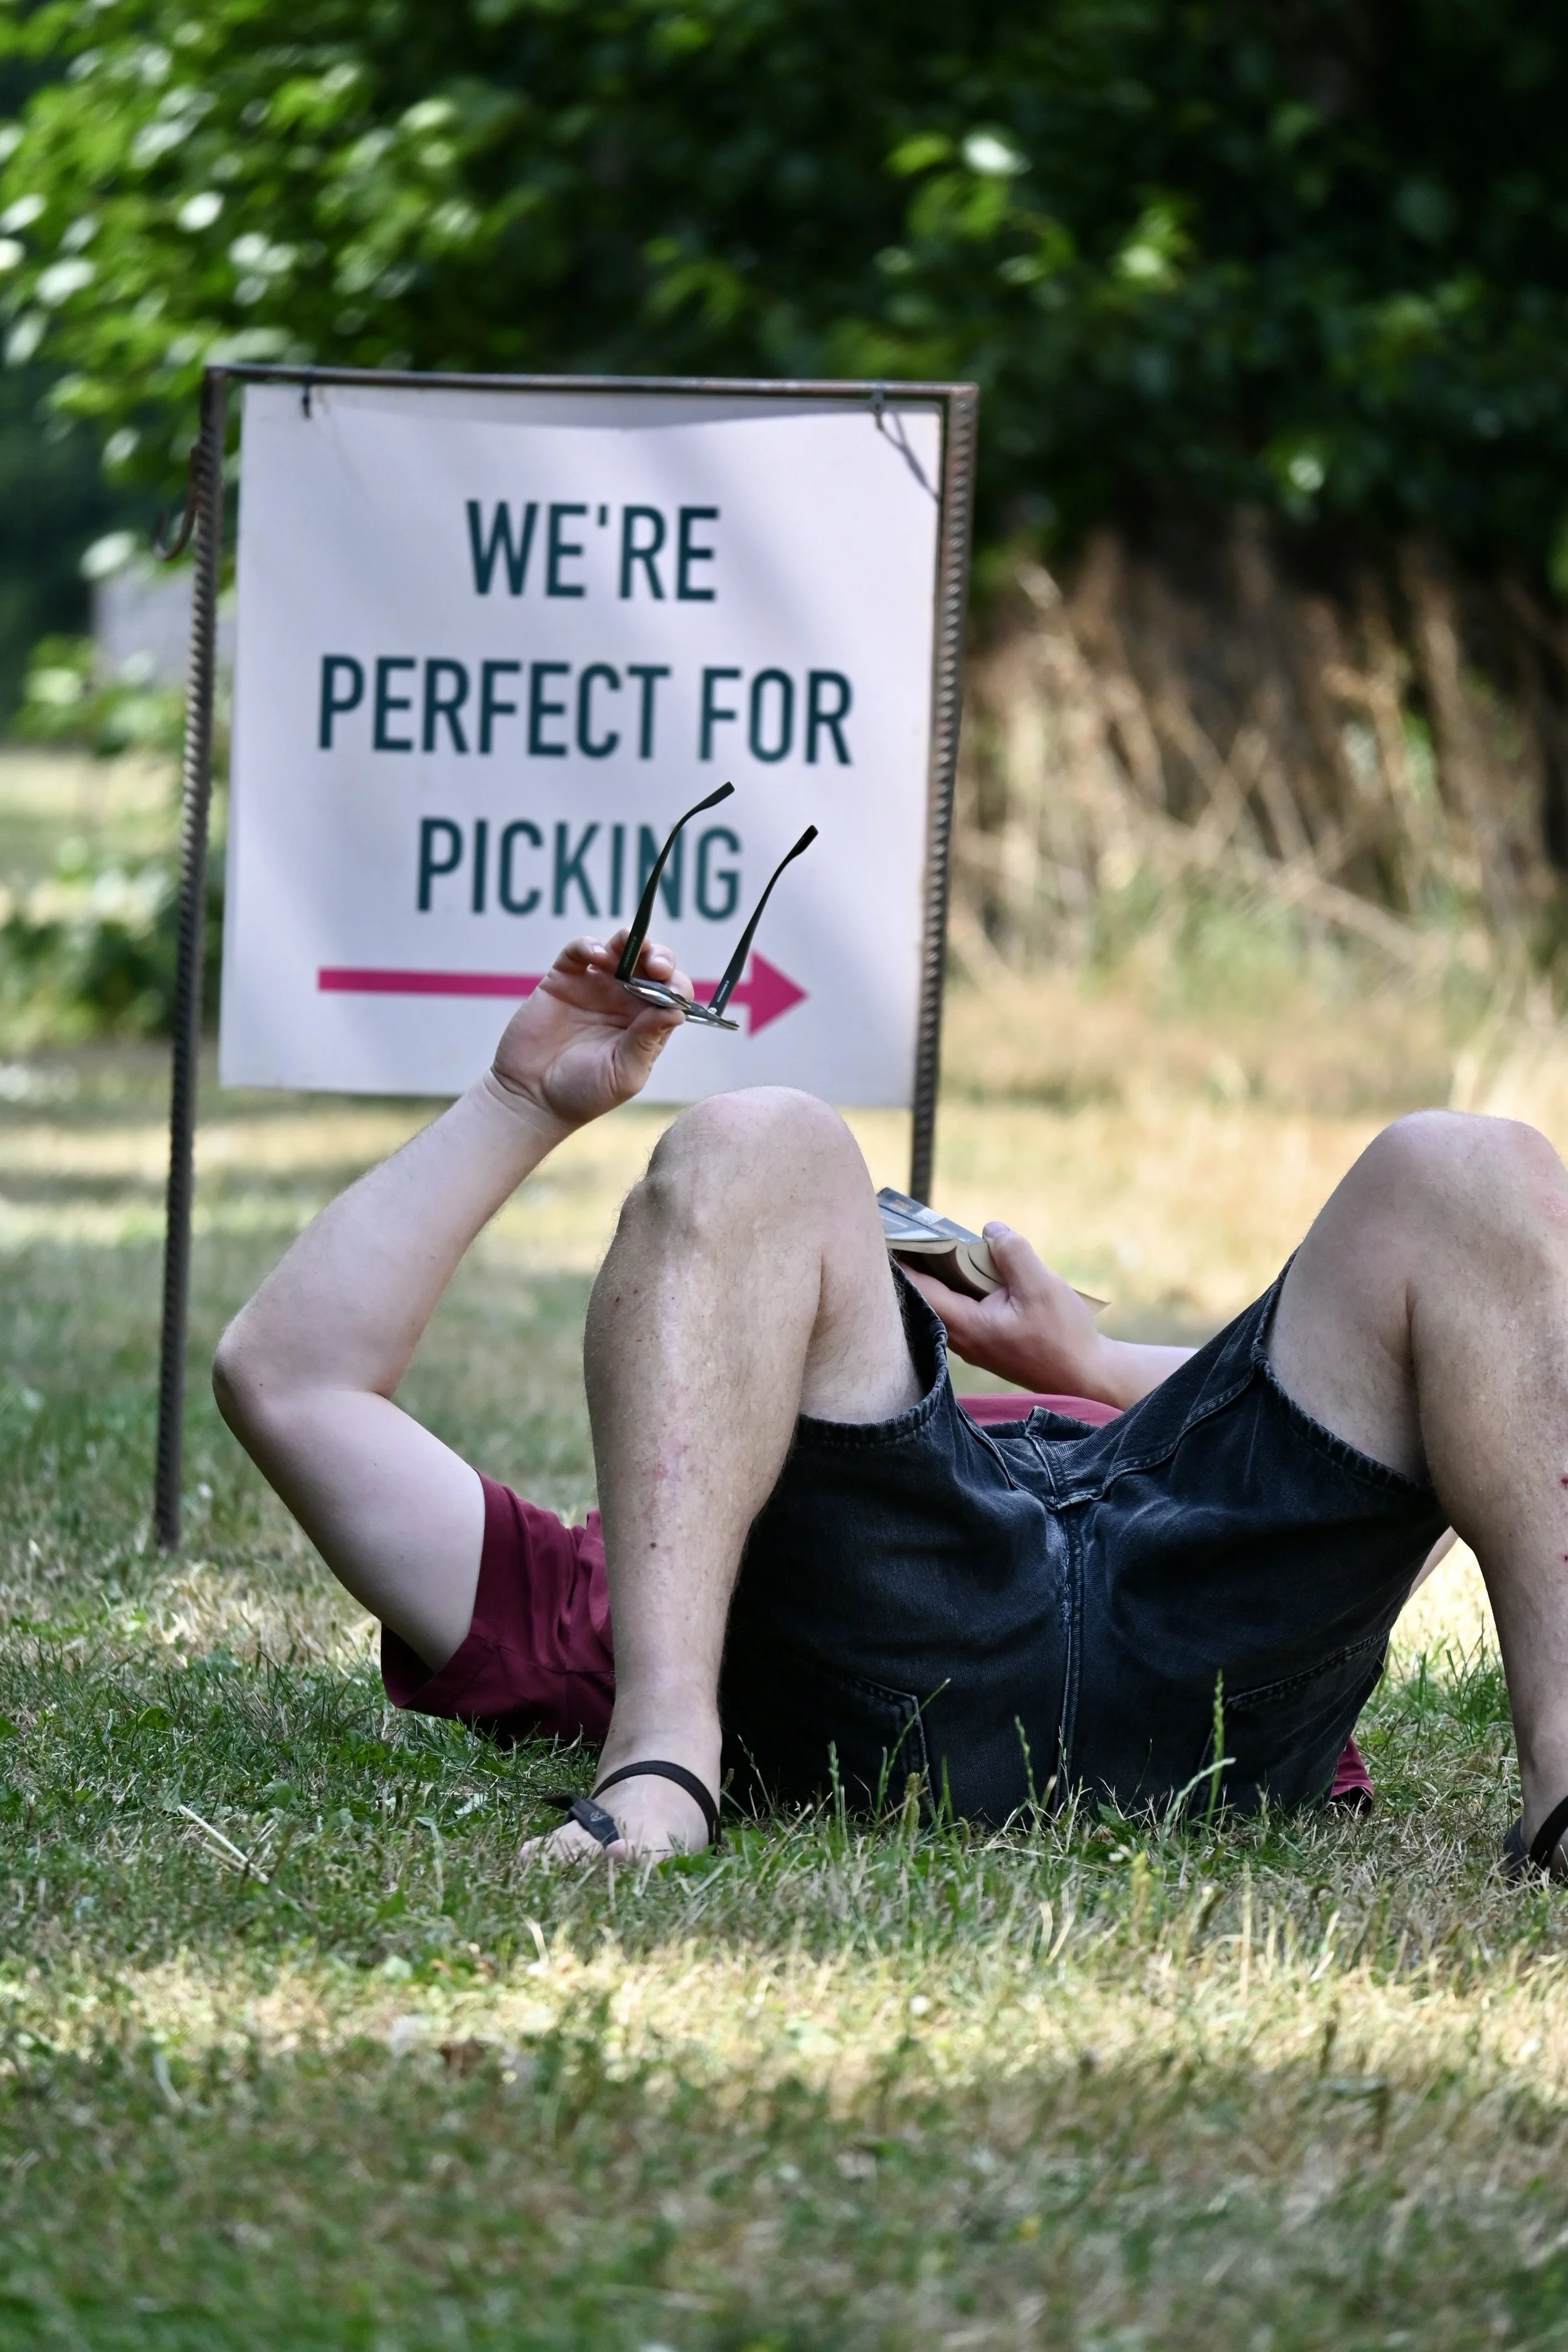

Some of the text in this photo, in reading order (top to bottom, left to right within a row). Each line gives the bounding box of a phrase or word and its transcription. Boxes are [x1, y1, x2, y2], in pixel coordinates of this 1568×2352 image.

[467, 500, 719, 601] WE'RE
[319, 655, 851, 765] PERFECT FOR
[417, 817, 741, 921] PICKING
